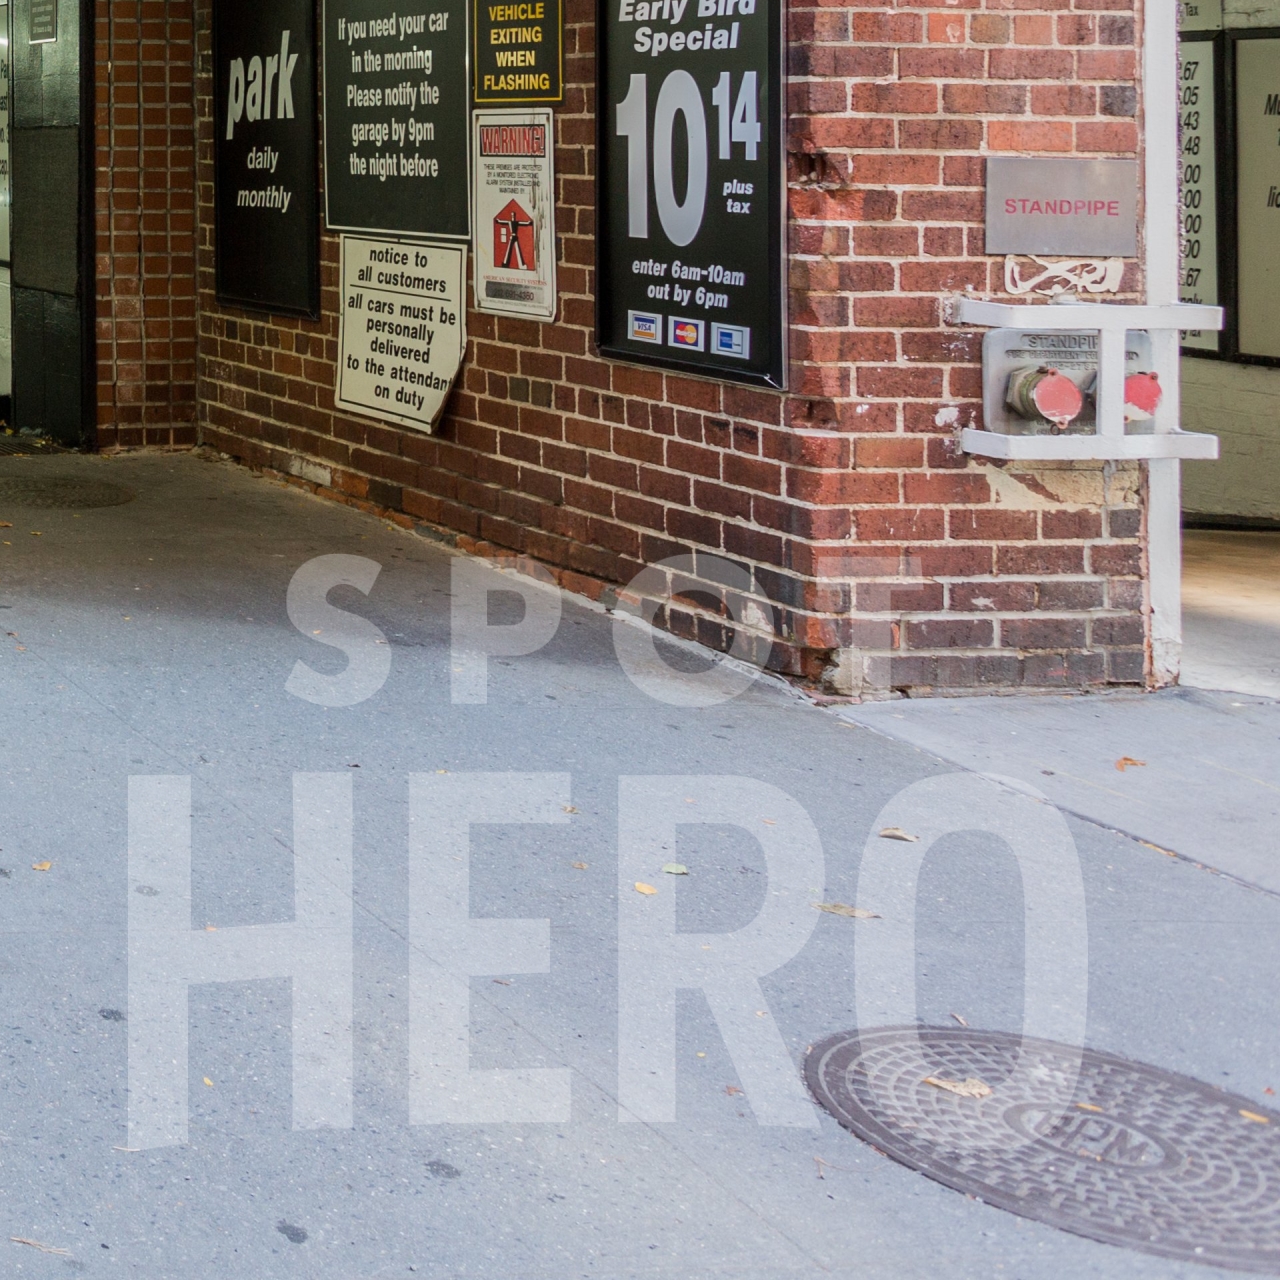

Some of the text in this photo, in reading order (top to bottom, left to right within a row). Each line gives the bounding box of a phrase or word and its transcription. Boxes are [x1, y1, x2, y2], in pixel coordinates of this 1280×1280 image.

[489, 2, 544, 21] VEHICLE
[338, 12, 449, 46] If you need your car
[490, 26, 542, 44] EXITING
[633, 22, 740, 57] Special
[352, 45, 432, 75] in the morning
[496, 50, 535, 67] WHEN
[226, 30, 299, 140] park
[484, 73, 550, 90] FLASHING
[347, 81, 440, 112] Please notify the
[352, 118, 434, 147] garage by 9pm
[481, 126, 545, 156] WARNING!
[247, 146, 279, 173] daily
[350, 152, 438, 182] the night before
[615, 69, 761, 247] 10 14
[237, 185, 291, 213] monthly
[723, 178, 754, 196] plus
[726, 198, 751, 214] tax
[1004, 198, 1120, 217] STANDPIPE
[370, 247, 428, 268] notice to
[358, 266, 446, 294] all customers
[632, 259, 745, 286] enter 6am-10am
[348, 293, 456, 326] all cars must be
[647, 284, 728, 309] out by 6pm
[366, 318, 434, 346] personally
[638, 322, 652, 332] VISA
[370, 337, 430, 364] delivered
[1030, 351, 1080, 360] DEPARTMENT
[347, 354, 360, 370] to
[365, 358, 385, 377] the
[374, 384, 425, 411] on duty
